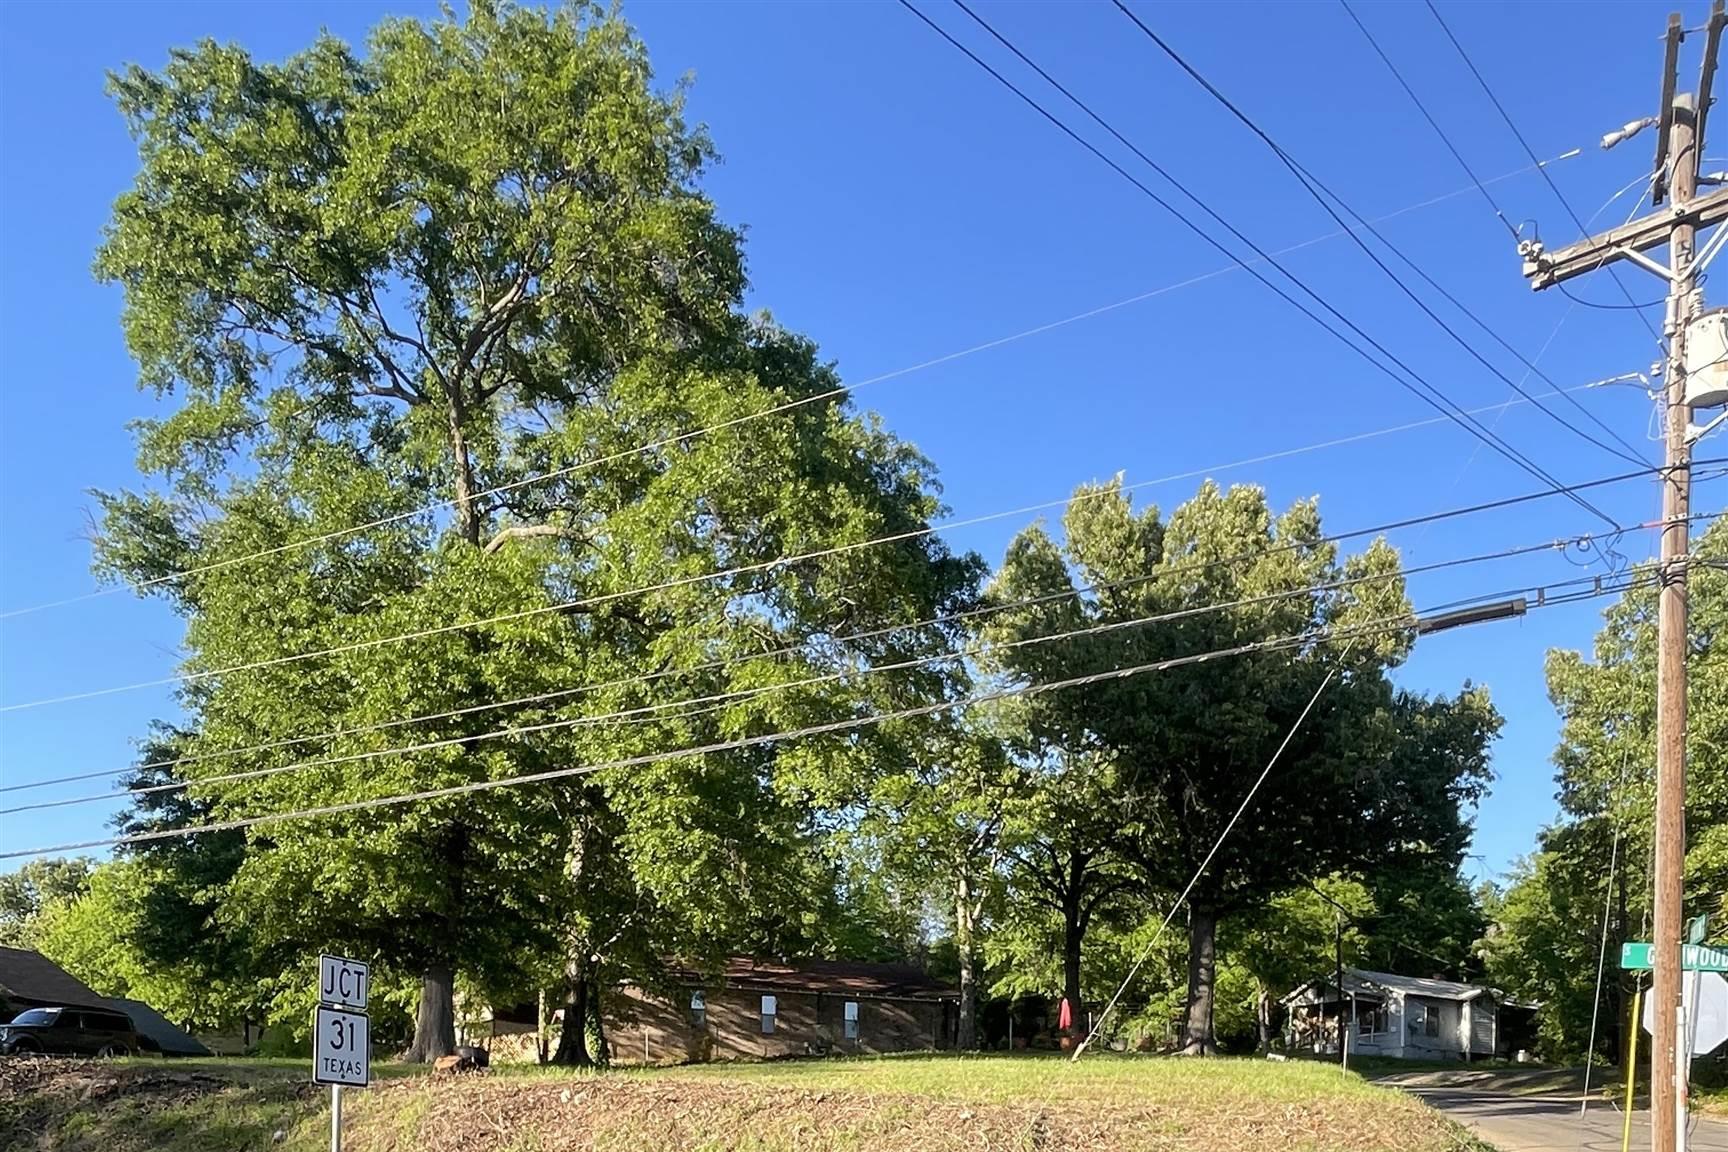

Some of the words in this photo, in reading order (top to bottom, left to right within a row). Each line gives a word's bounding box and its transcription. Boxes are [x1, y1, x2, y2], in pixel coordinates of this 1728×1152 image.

[1624, 946, 1632, 956] S
[324, 966, 364, 1000] JCT
[330, 1019, 354, 1051] 31
[324, 1058, 361, 1075] TEXAS
